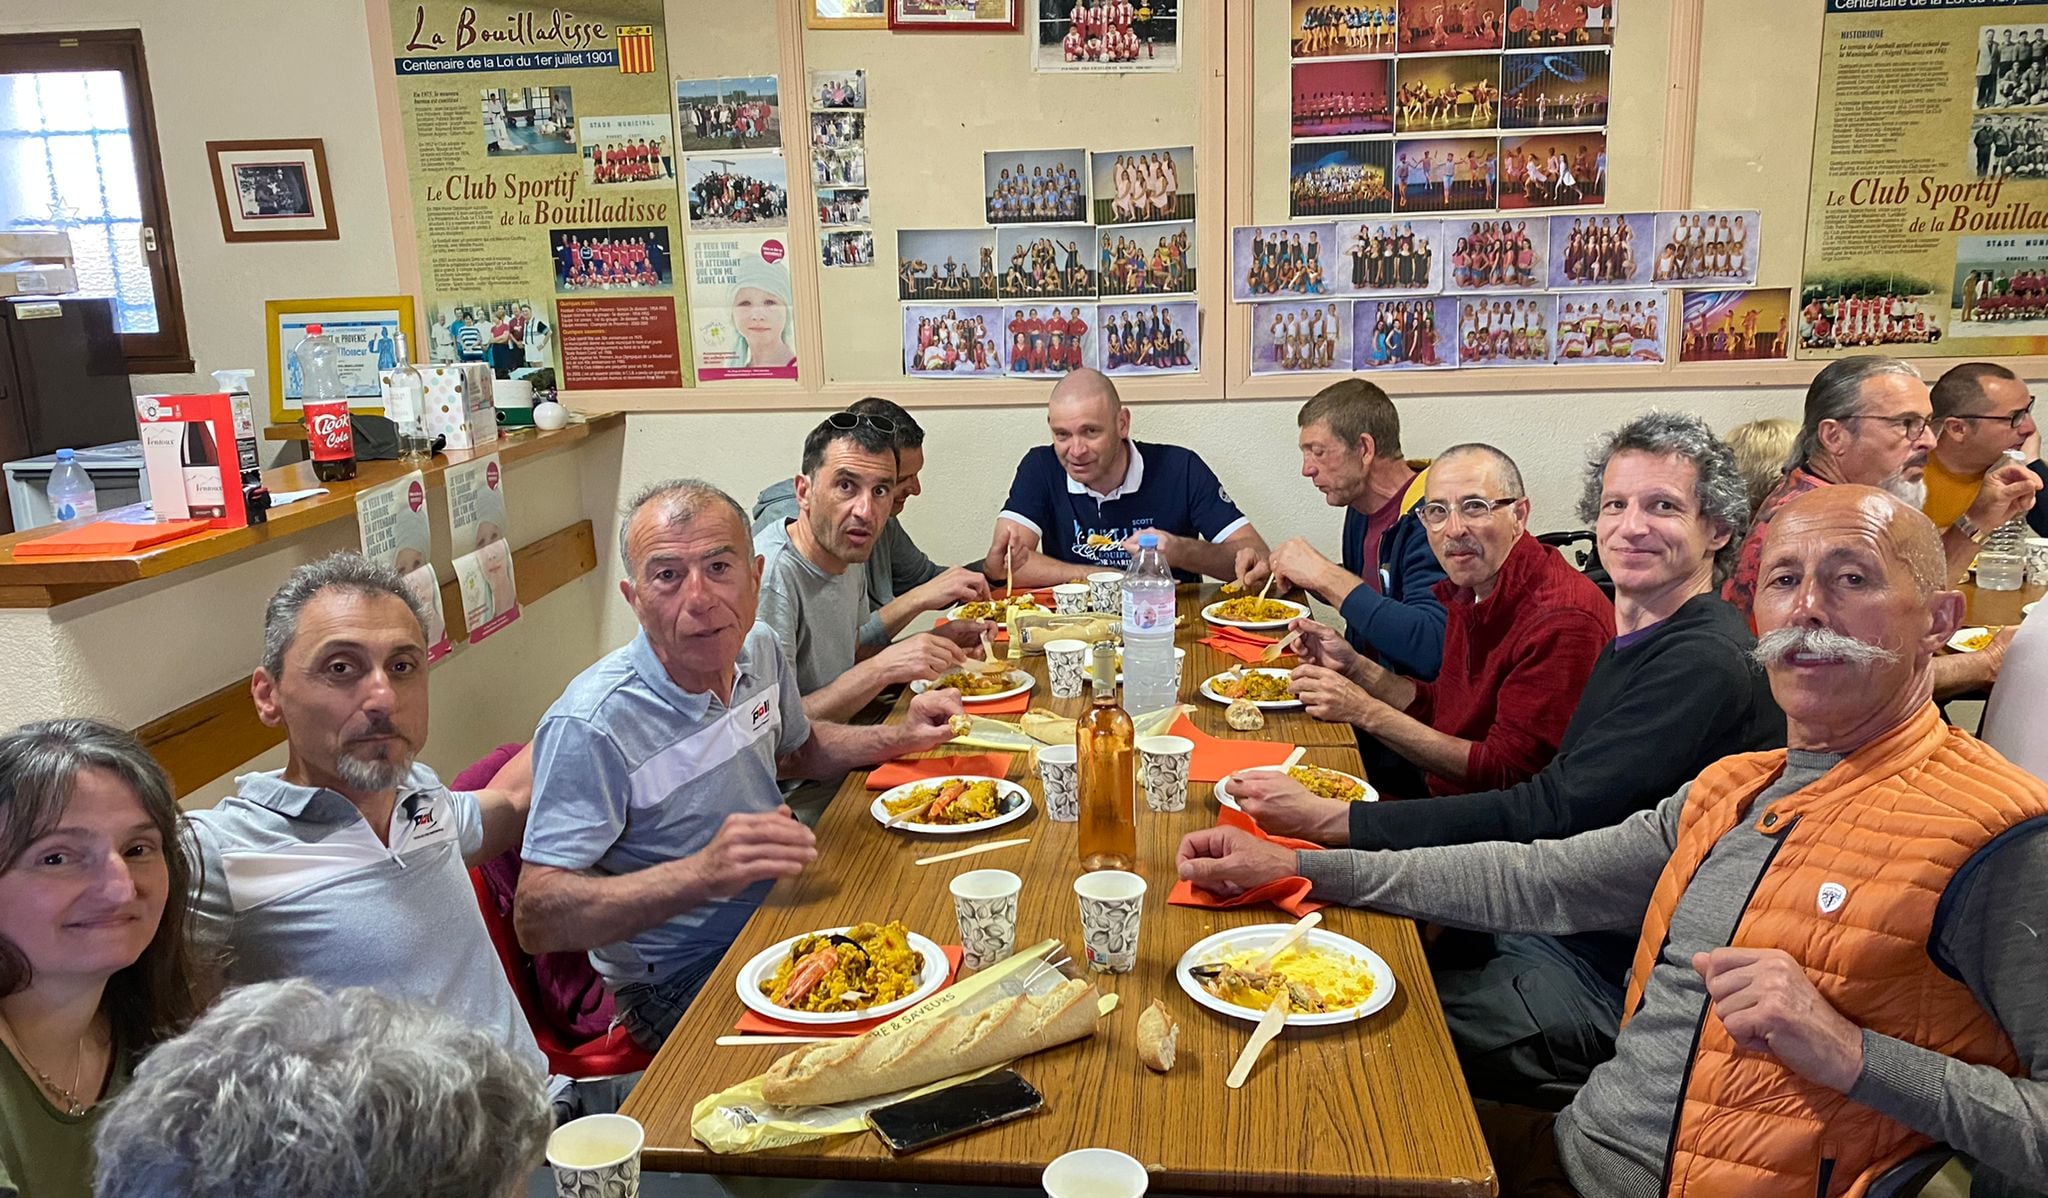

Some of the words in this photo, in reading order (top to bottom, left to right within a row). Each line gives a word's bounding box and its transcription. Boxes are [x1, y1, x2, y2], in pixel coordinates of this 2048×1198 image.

[407, 6, 446, 51] La
[457, 7, 608, 50] Bouilladisse
[1841, 30, 1884, 39] HISTORIQUE
[402, 56, 464, 72] Centenaire
[467, 57, 481, 68] de
[484, 56, 494, 68] la
[497, 55, 514, 68] Loi
[517, 54, 531, 66] du
[535, 53, 551, 66] 1er
[554, 51, 583, 68] juillet
[586, 51, 613, 64] 1901
[427, 186, 442, 202] Le
[447, 173, 497, 201] Club
[505, 170, 580, 205] Sportif
[1826, 191, 1845, 207] Le
[1850, 177, 1910, 206] Club
[1916, 174, 2004, 210] Sportif
[501, 211, 517, 226] de
[520, 211, 531, 226] la
[535, 197, 668, 226] Bouilladisse
[1910, 217, 1927, 233] de
[1931, 217, 1945, 232] la
[695, 242, 701, 250] JE
[703, 242, 719, 250] VEUX
[720, 241, 740, 250] VIVRE
[695, 250, 702, 259] ET
[704, 249, 731, 258] SOURIRE
[696, 259, 704, 268] EN
[705, 258, 741, 267] ATTENDANT
[696, 268, 708, 277] QUE
[724, 267, 734, 275] ME
[697, 276, 716, 284] SAUVE
[717, 276, 726, 284] LA
[726, 275, 737, 284] VIE
[341, 333, 368, 343] PROVENCE
[326, 431, 349, 448] Cola
[362, 500, 368, 512] JE
[368, 495, 380, 509] VEUX
[381, 490, 394, 505] VIVRE
[458, 489, 478, 506] ATTENDANT
[363, 510, 369, 524] ET
[370, 504, 390, 521] SOURIRE
[465, 513, 471, 524] LA
[1131, 518, 1154, 526] SCOTT
[364, 523, 371, 537] EN
[372, 513, 397, 534] ATTENDANT
[366, 534, 375, 546] QUE
[385, 526, 392, 539] ME
[367, 543, 382, 557] SAUVE
[382, 540, 389, 552] LA
[388, 537, 396, 550] VIE
[1098, 551, 1130, 559] EQUIPE
[892, 1021, 903, 1032] &
[904, 993, 955, 1024] SAVEURS
